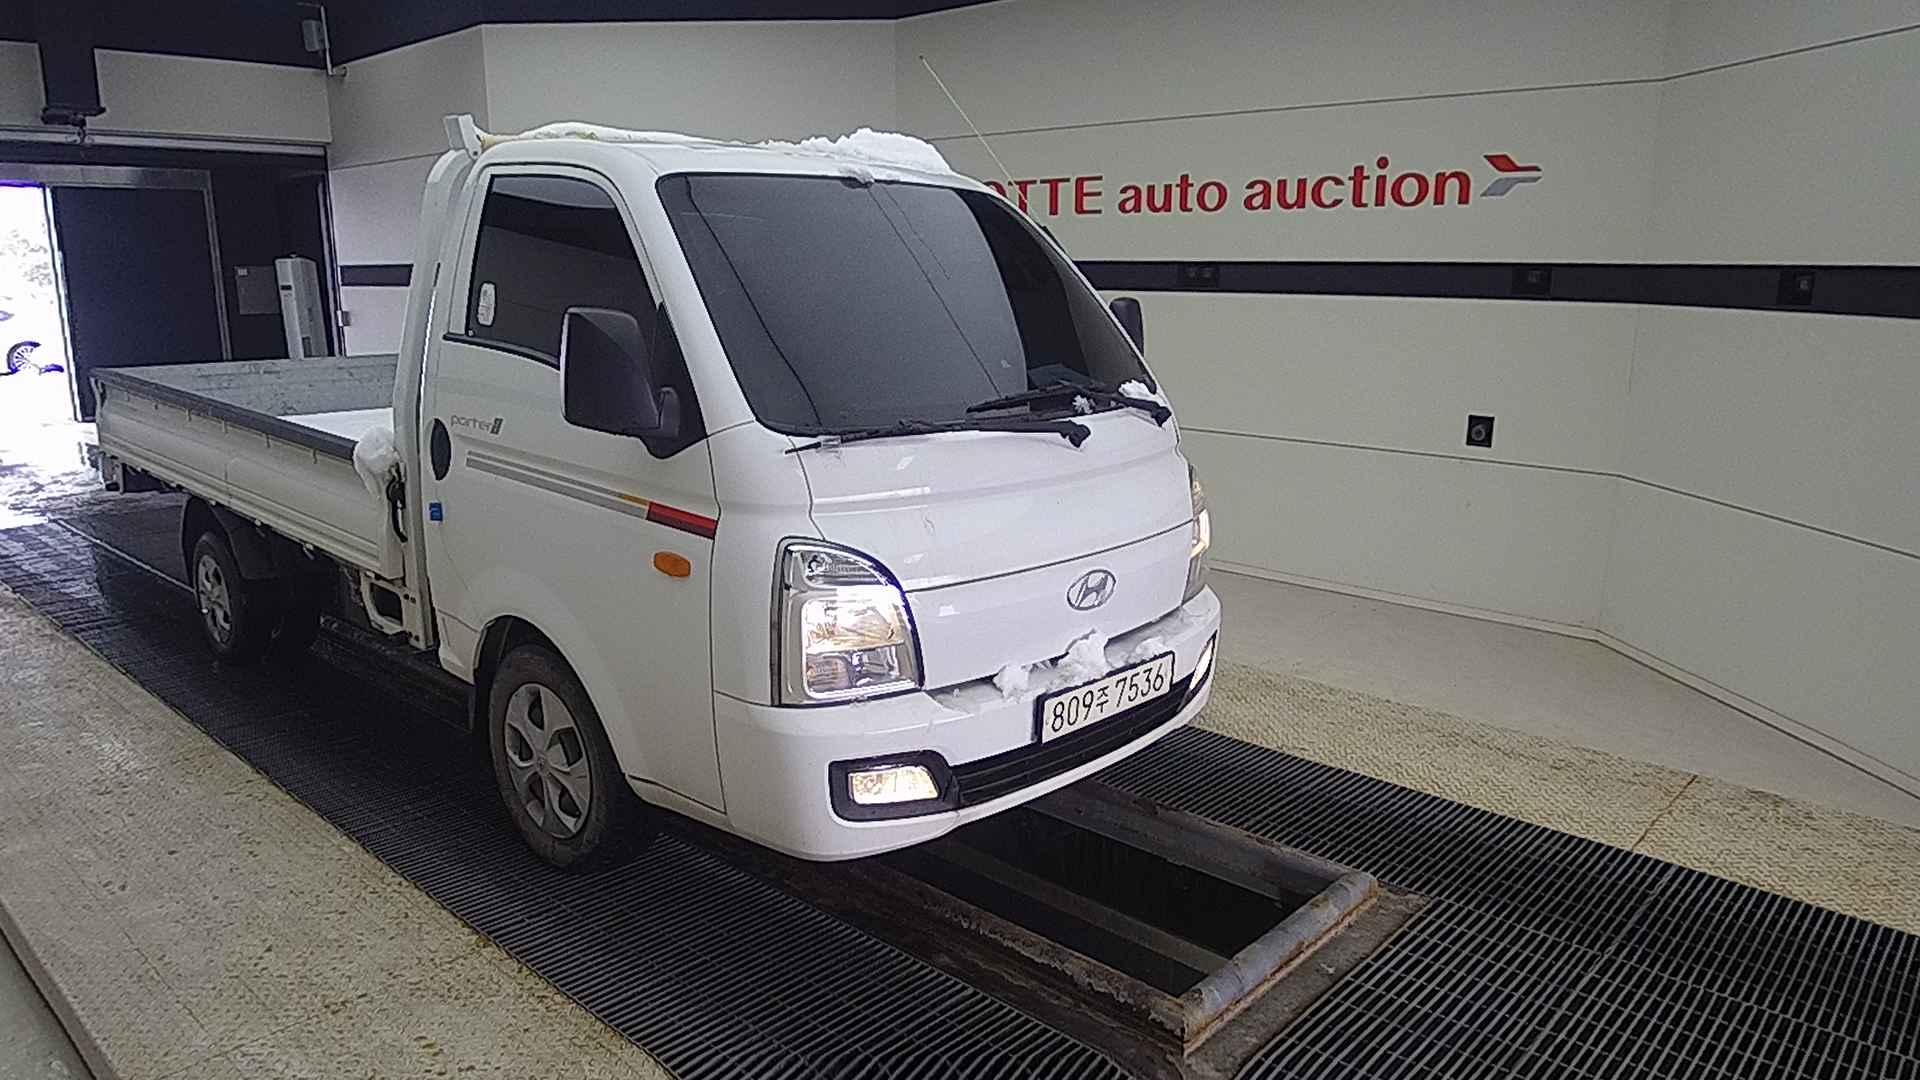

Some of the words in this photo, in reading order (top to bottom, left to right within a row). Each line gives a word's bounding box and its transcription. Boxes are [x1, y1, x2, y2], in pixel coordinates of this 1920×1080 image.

[1118, 173, 1228, 214] auto
[1243, 156, 1472, 211] auction
[1115, 663, 1165, 707] 7536
